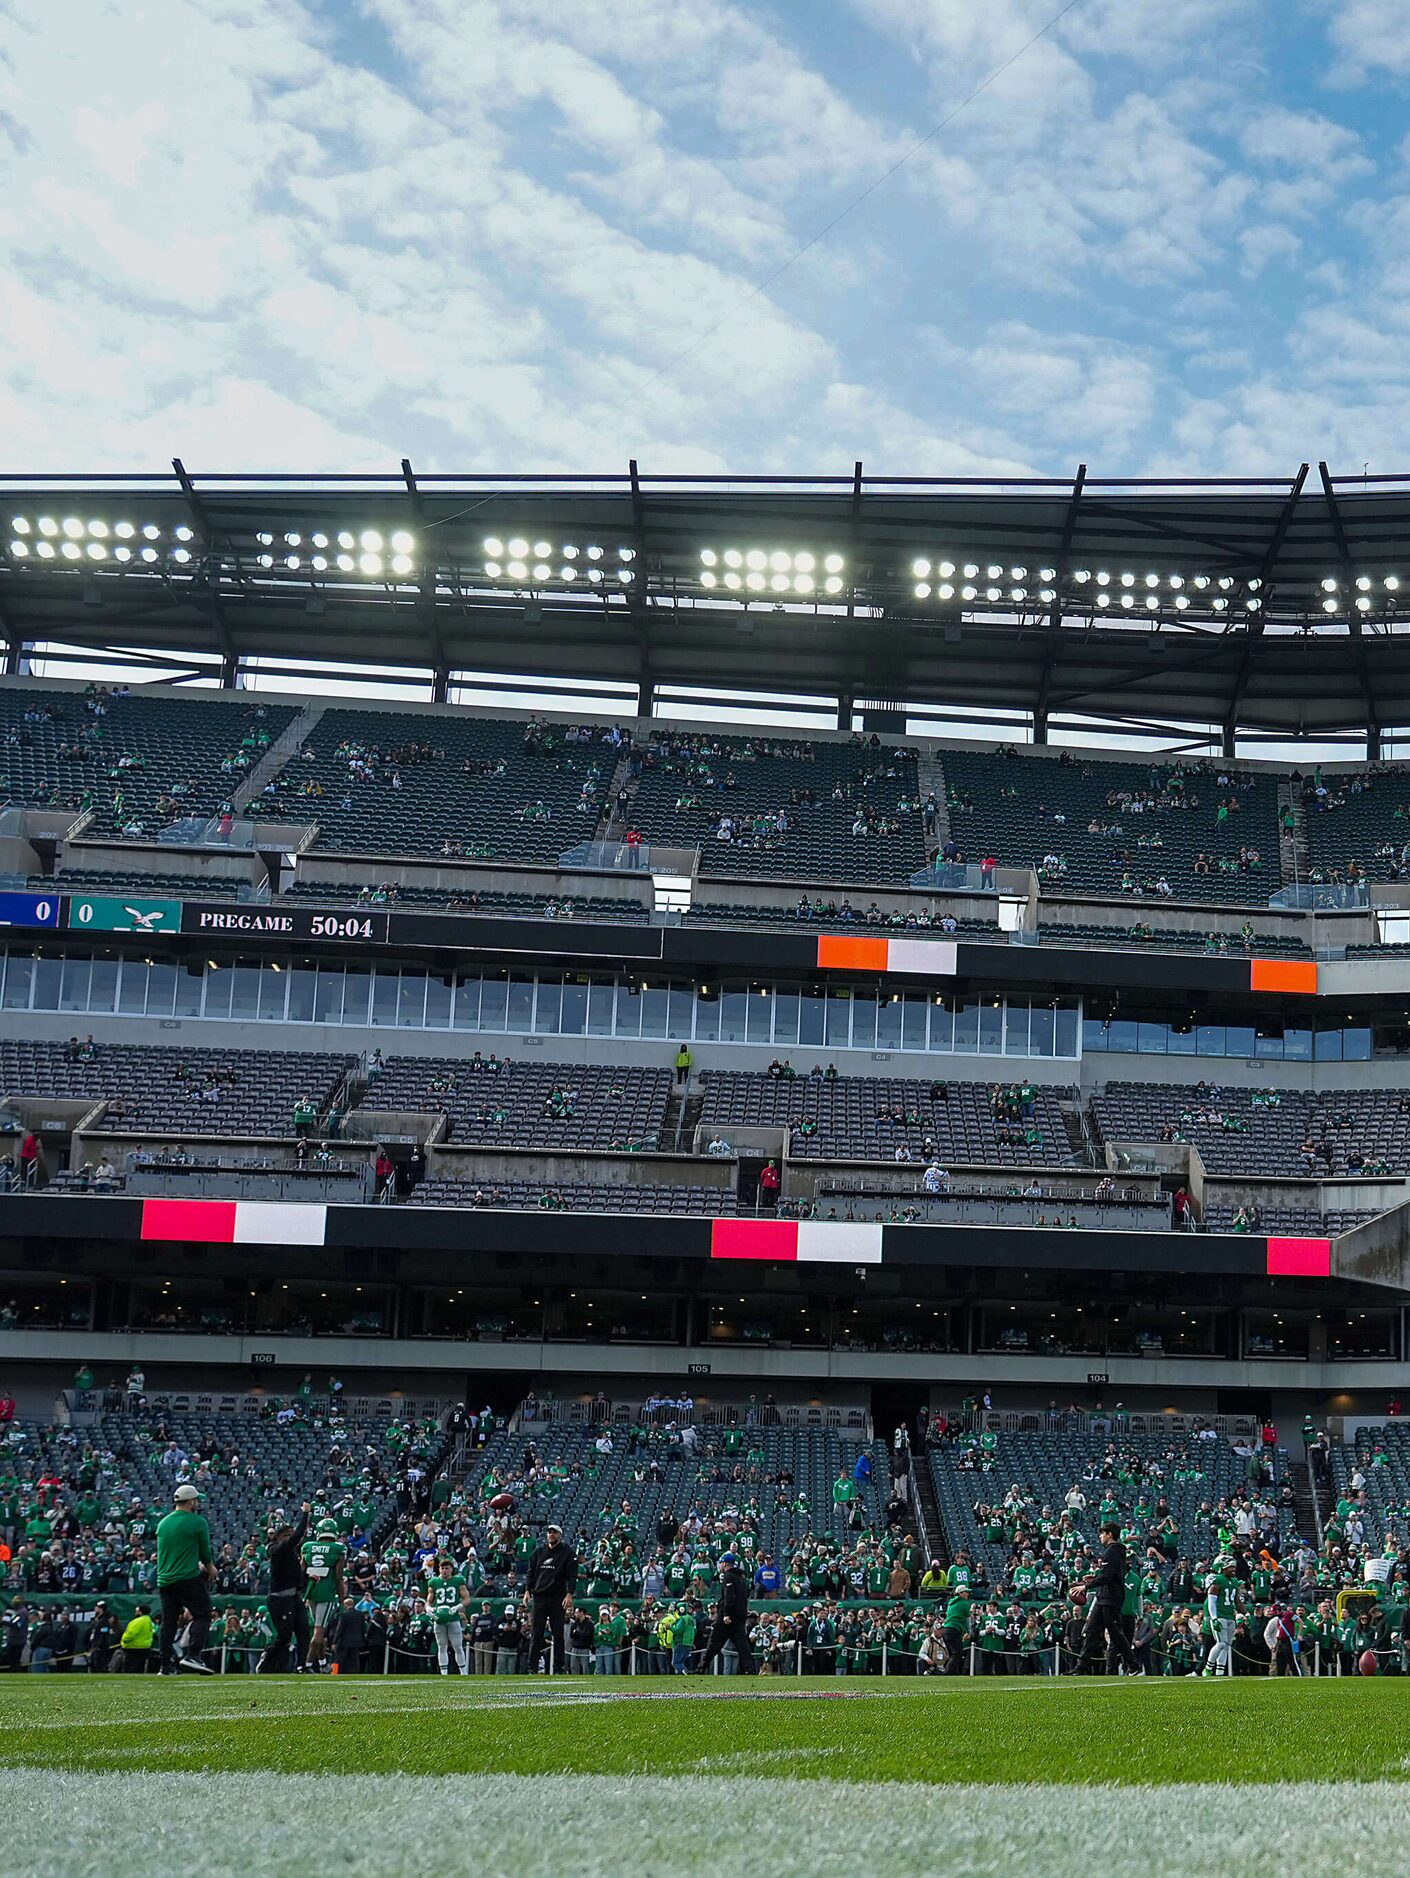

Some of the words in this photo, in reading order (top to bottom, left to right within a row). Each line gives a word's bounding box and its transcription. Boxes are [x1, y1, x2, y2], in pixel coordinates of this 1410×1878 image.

[36, 901, 51, 920] 0
[78, 903, 94, 923] 0
[199, 911, 293, 932] PREGAME
[310, 915, 374, 939] 50:04
[713, 1145, 722, 1154] 92
[252, 1353, 273, 1363] 106
[690, 1364, 709, 1374] 105
[1089, 1374, 1107, 1383] 104
[730, 1434, 734, 1444] 1
[314, 1506, 326, 1516] 20
[132, 1524, 145, 1534] 20
[522, 1541, 528, 1552] 1
[740, 1536, 752, 1548] 98
[311, 1545, 330, 1554] SMITH
[906, 1550, 911, 1560] 1
[62, 1566, 76, 1578] 26
[672, 1568, 684, 1578] 62
[620, 1574, 630, 1586] 17
[876, 1572, 881, 1585] 1
[1019, 1574, 1031, 1585] 33
[1260, 1576, 1264, 1588] 1
[436, 1586, 456, 1605] 33
[1224, 1588, 1238, 1606] 14
